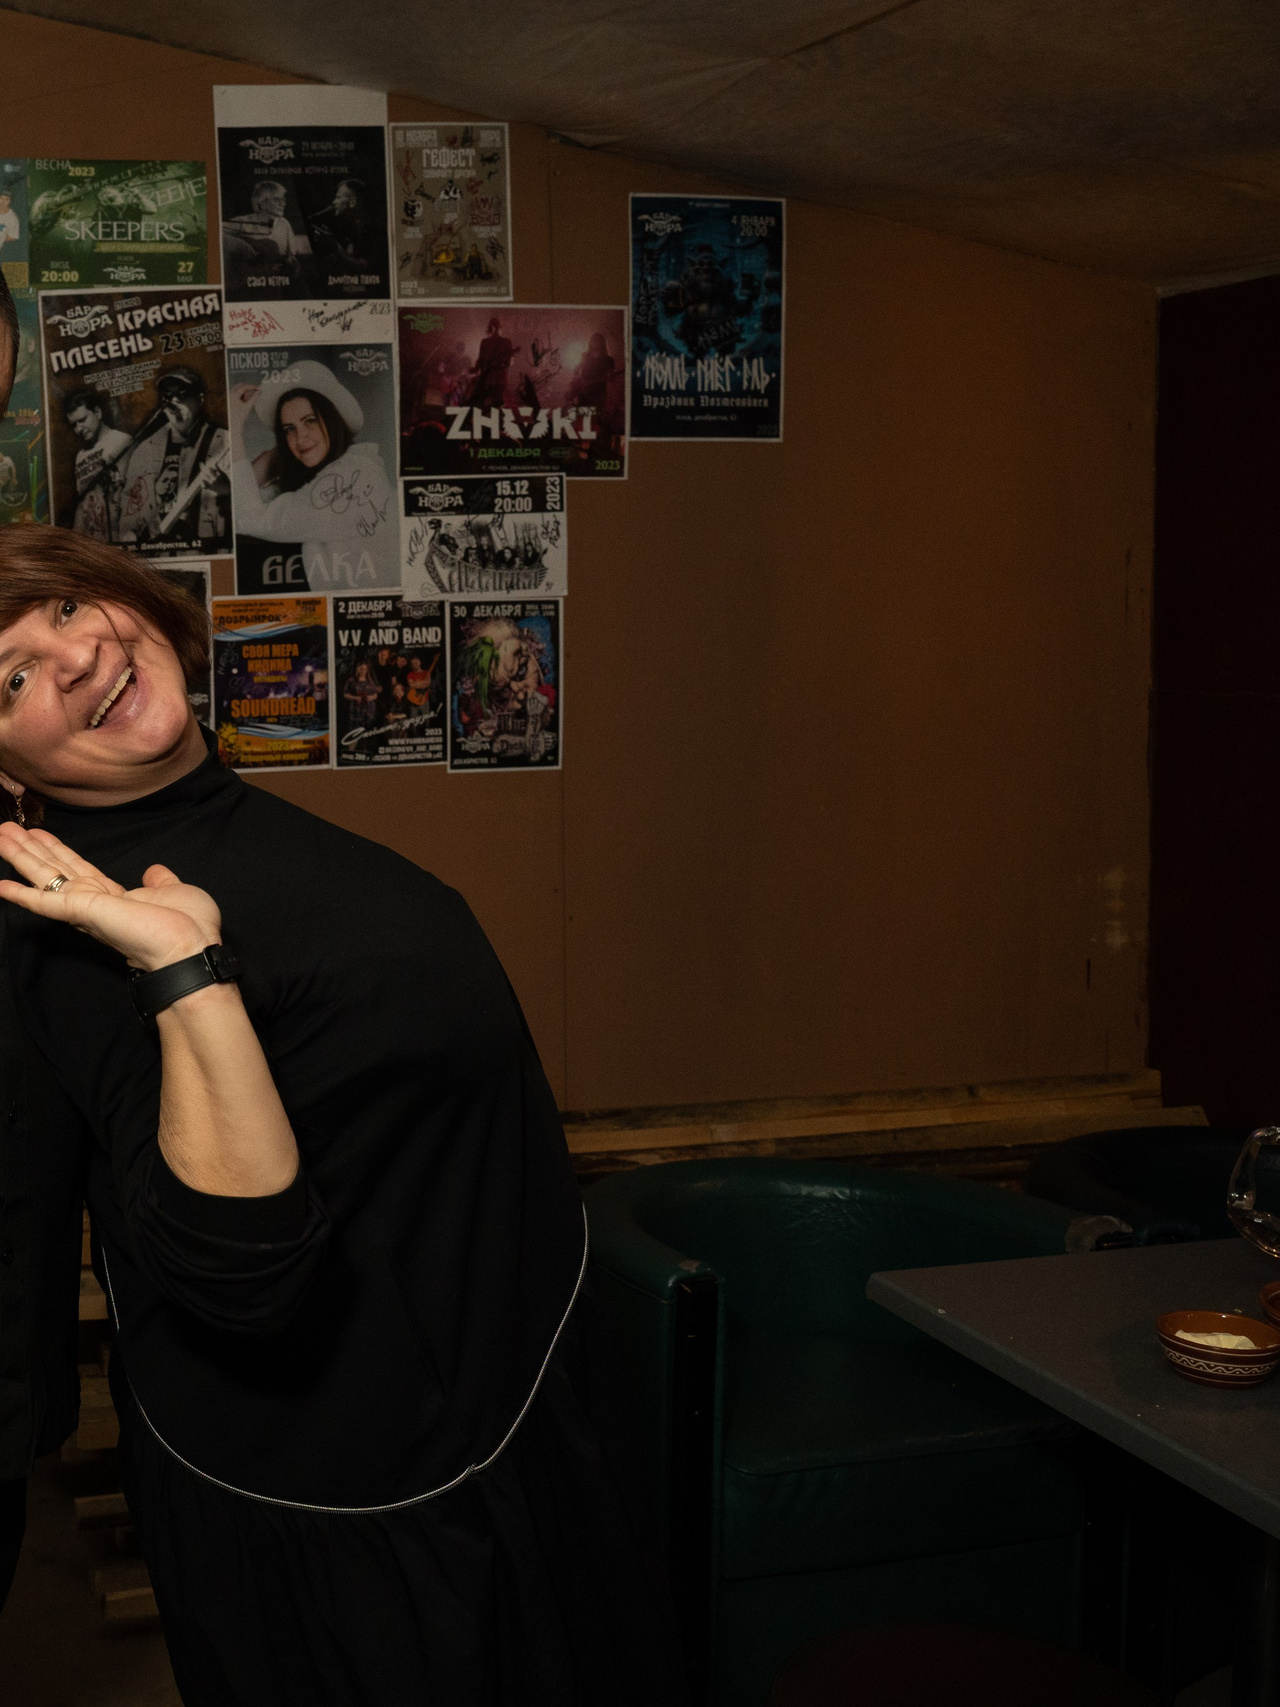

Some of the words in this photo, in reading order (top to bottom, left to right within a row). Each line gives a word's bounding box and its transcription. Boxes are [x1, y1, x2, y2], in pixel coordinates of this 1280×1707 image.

[248, 148, 295, 164] НОРА
[35, 160, 72, 171] ВЕСНА
[68, 166, 96, 177] 2023
[65, 220, 186, 242] SKEEPERS
[178, 262, 195, 274] 27
[41, 271, 79, 283] 20:00
[66, 305, 93, 318] БАР
[117, 293, 221, 333] КРАСНАЯ
[58, 314, 113, 338] НОРА
[160, 331, 186, 355] 23
[188, 332, 223, 348] 19:00
[50, 332, 153, 373] ПЛЕСЕНЬ
[230, 351, 270, 369] ПСКОВ
[260, 370, 301, 383] 2023
[348, 360, 388, 376] НОРА
[445, 405, 598, 441] ZHUKI
[477, 448, 542, 459] ДЕКАБРЯ
[595, 460, 621, 471] 2023
[428, 484, 450, 493] БАР
[494, 479, 531, 497] 15.12
[546, 476, 562, 511] 2023
[419, 495, 464, 512] НОРА
[494, 496, 533, 513] 20:00
[338, 601, 346, 614] 2
[347, 599, 393, 616] ДЕКАБРЯ
[453, 605, 468, 619] 30
[472, 603, 523, 619] ДЕКАБРЯ
[338, 628, 365, 648] V.V.
[368, 627, 400, 647] AND
[402, 625, 443, 645] BAND
[230, 696, 317, 718] SOUNDHEAD
